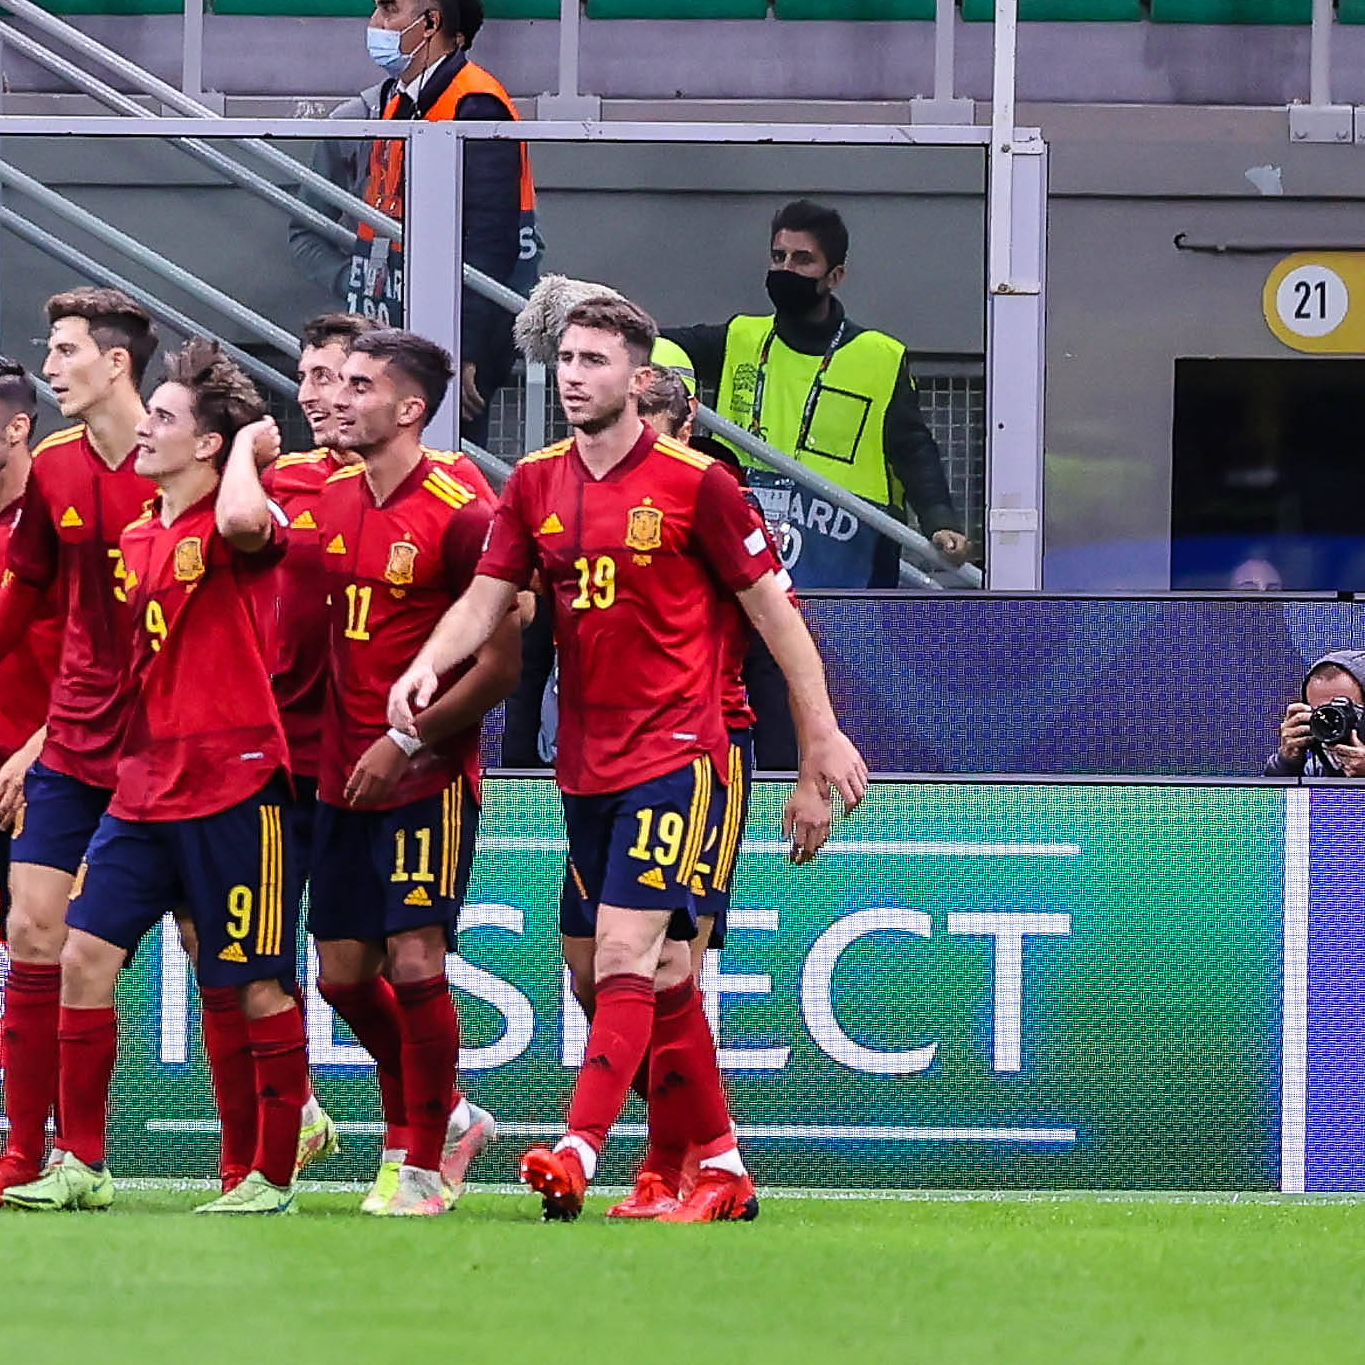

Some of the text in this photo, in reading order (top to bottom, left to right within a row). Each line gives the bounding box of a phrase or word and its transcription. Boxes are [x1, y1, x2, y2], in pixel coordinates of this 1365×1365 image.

[1293, 280, 1327, 320] 21
[571, 555, 616, 609] 19
[146, 600, 168, 652] 9
[344, 584, 372, 640] 11
[390, 827, 435, 882] 11
[628, 808, 684, 866] 19
[226, 885, 253, 939] 9
